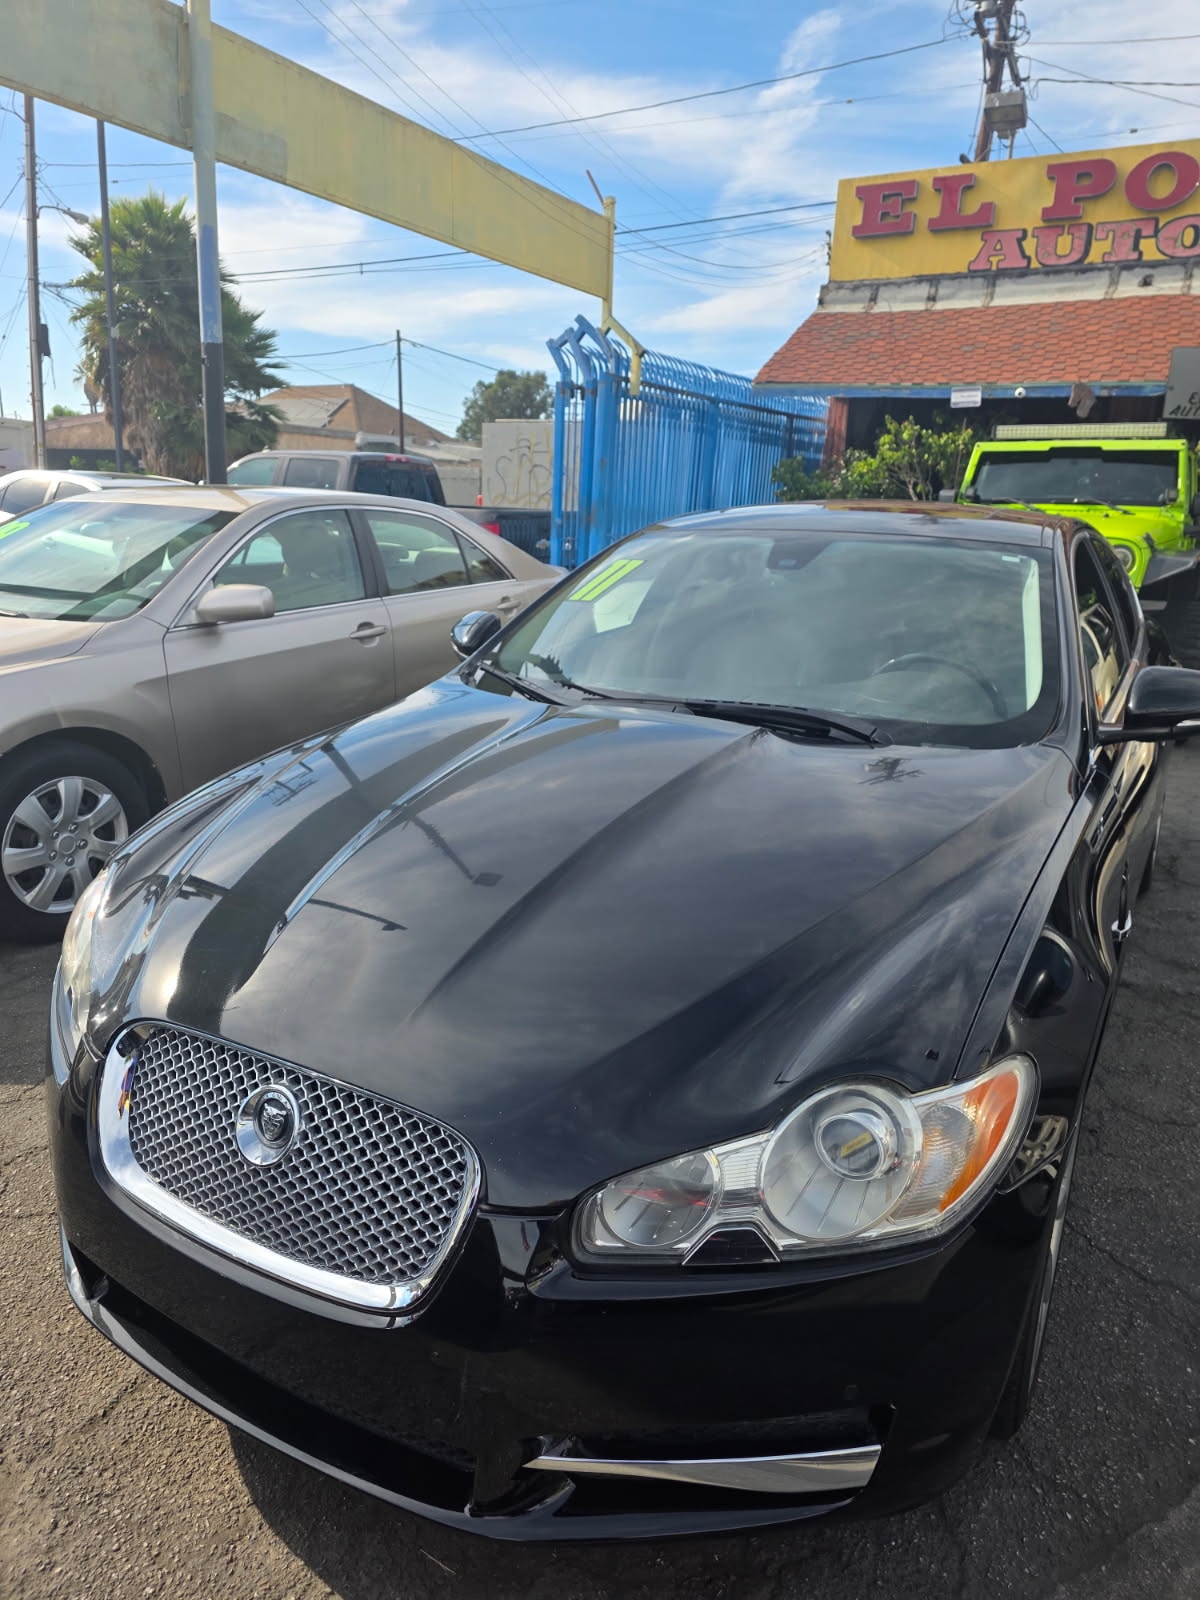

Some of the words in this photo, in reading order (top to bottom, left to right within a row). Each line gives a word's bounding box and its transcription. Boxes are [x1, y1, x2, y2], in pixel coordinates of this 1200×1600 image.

[852, 172, 995, 238] EL
[1041, 151, 1199, 221] PO
[967, 214, 1200, 272] AUTO
